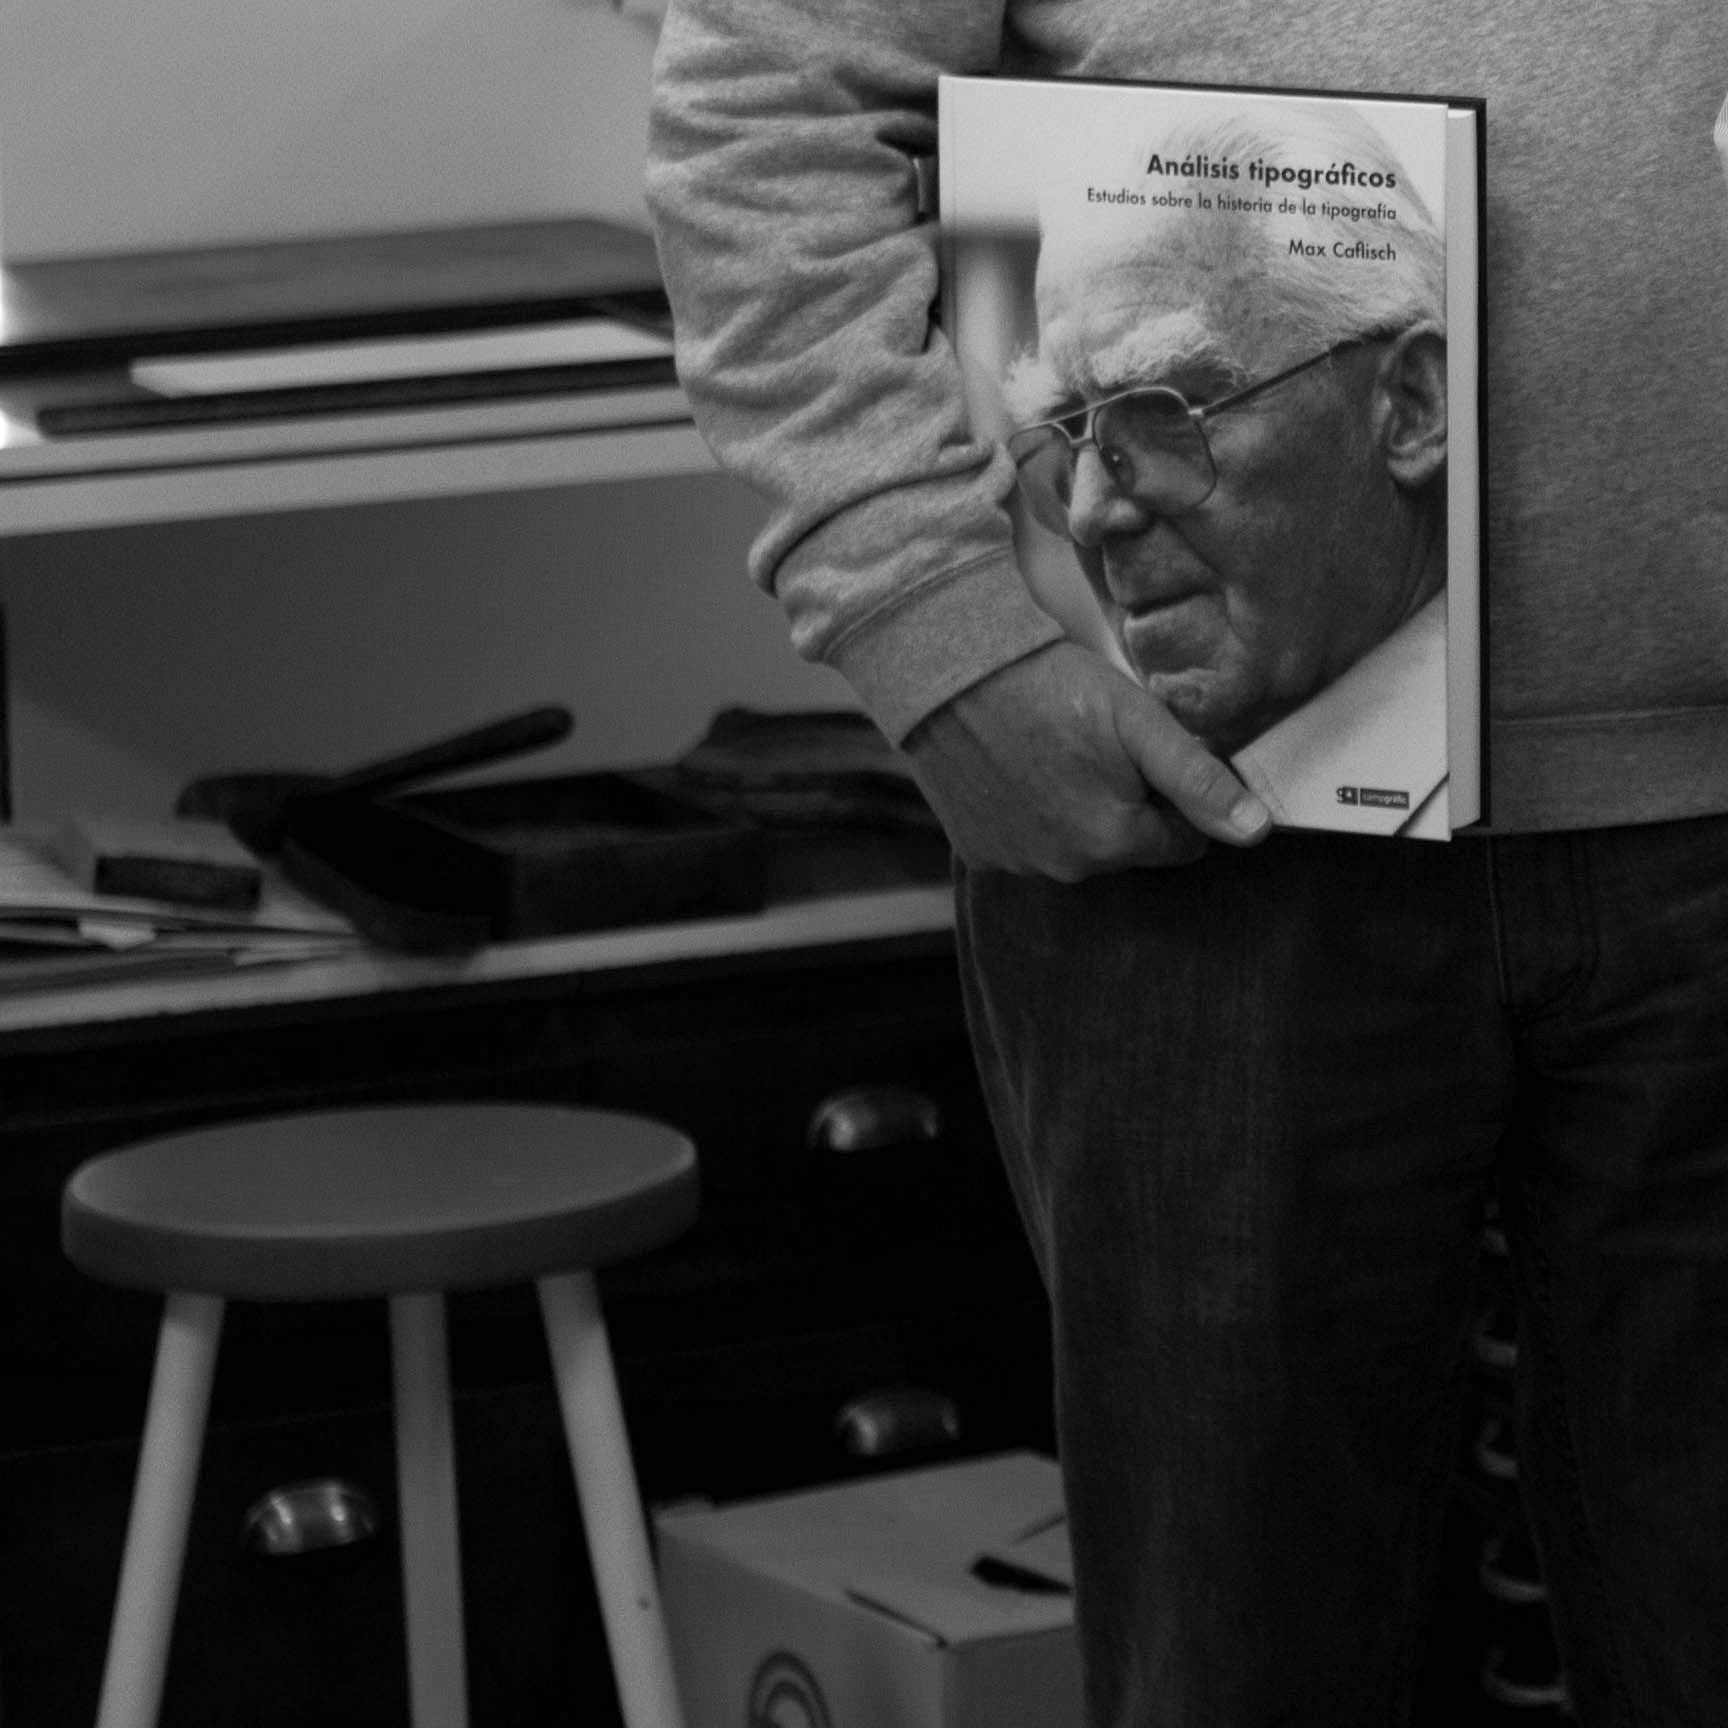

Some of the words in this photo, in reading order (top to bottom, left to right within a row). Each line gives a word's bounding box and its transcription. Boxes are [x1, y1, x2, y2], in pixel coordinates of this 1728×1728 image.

[1146, 153, 1240, 181] Análisis
[1248, 157, 1397, 191] tipográficos
[1086, 187, 1147, 206] Estudios
[1151, 191, 1193, 209] sobre
[1198, 192, 1212, 210] la
[1217, 193, 1273, 214] historia
[1278, 197, 1297, 215] de
[1302, 198, 1317, 216] la
[1321, 201, 1397, 222] tipografía
[1288, 239, 1326, 257] Max
[1332, 241, 1397, 262] Caflisch
